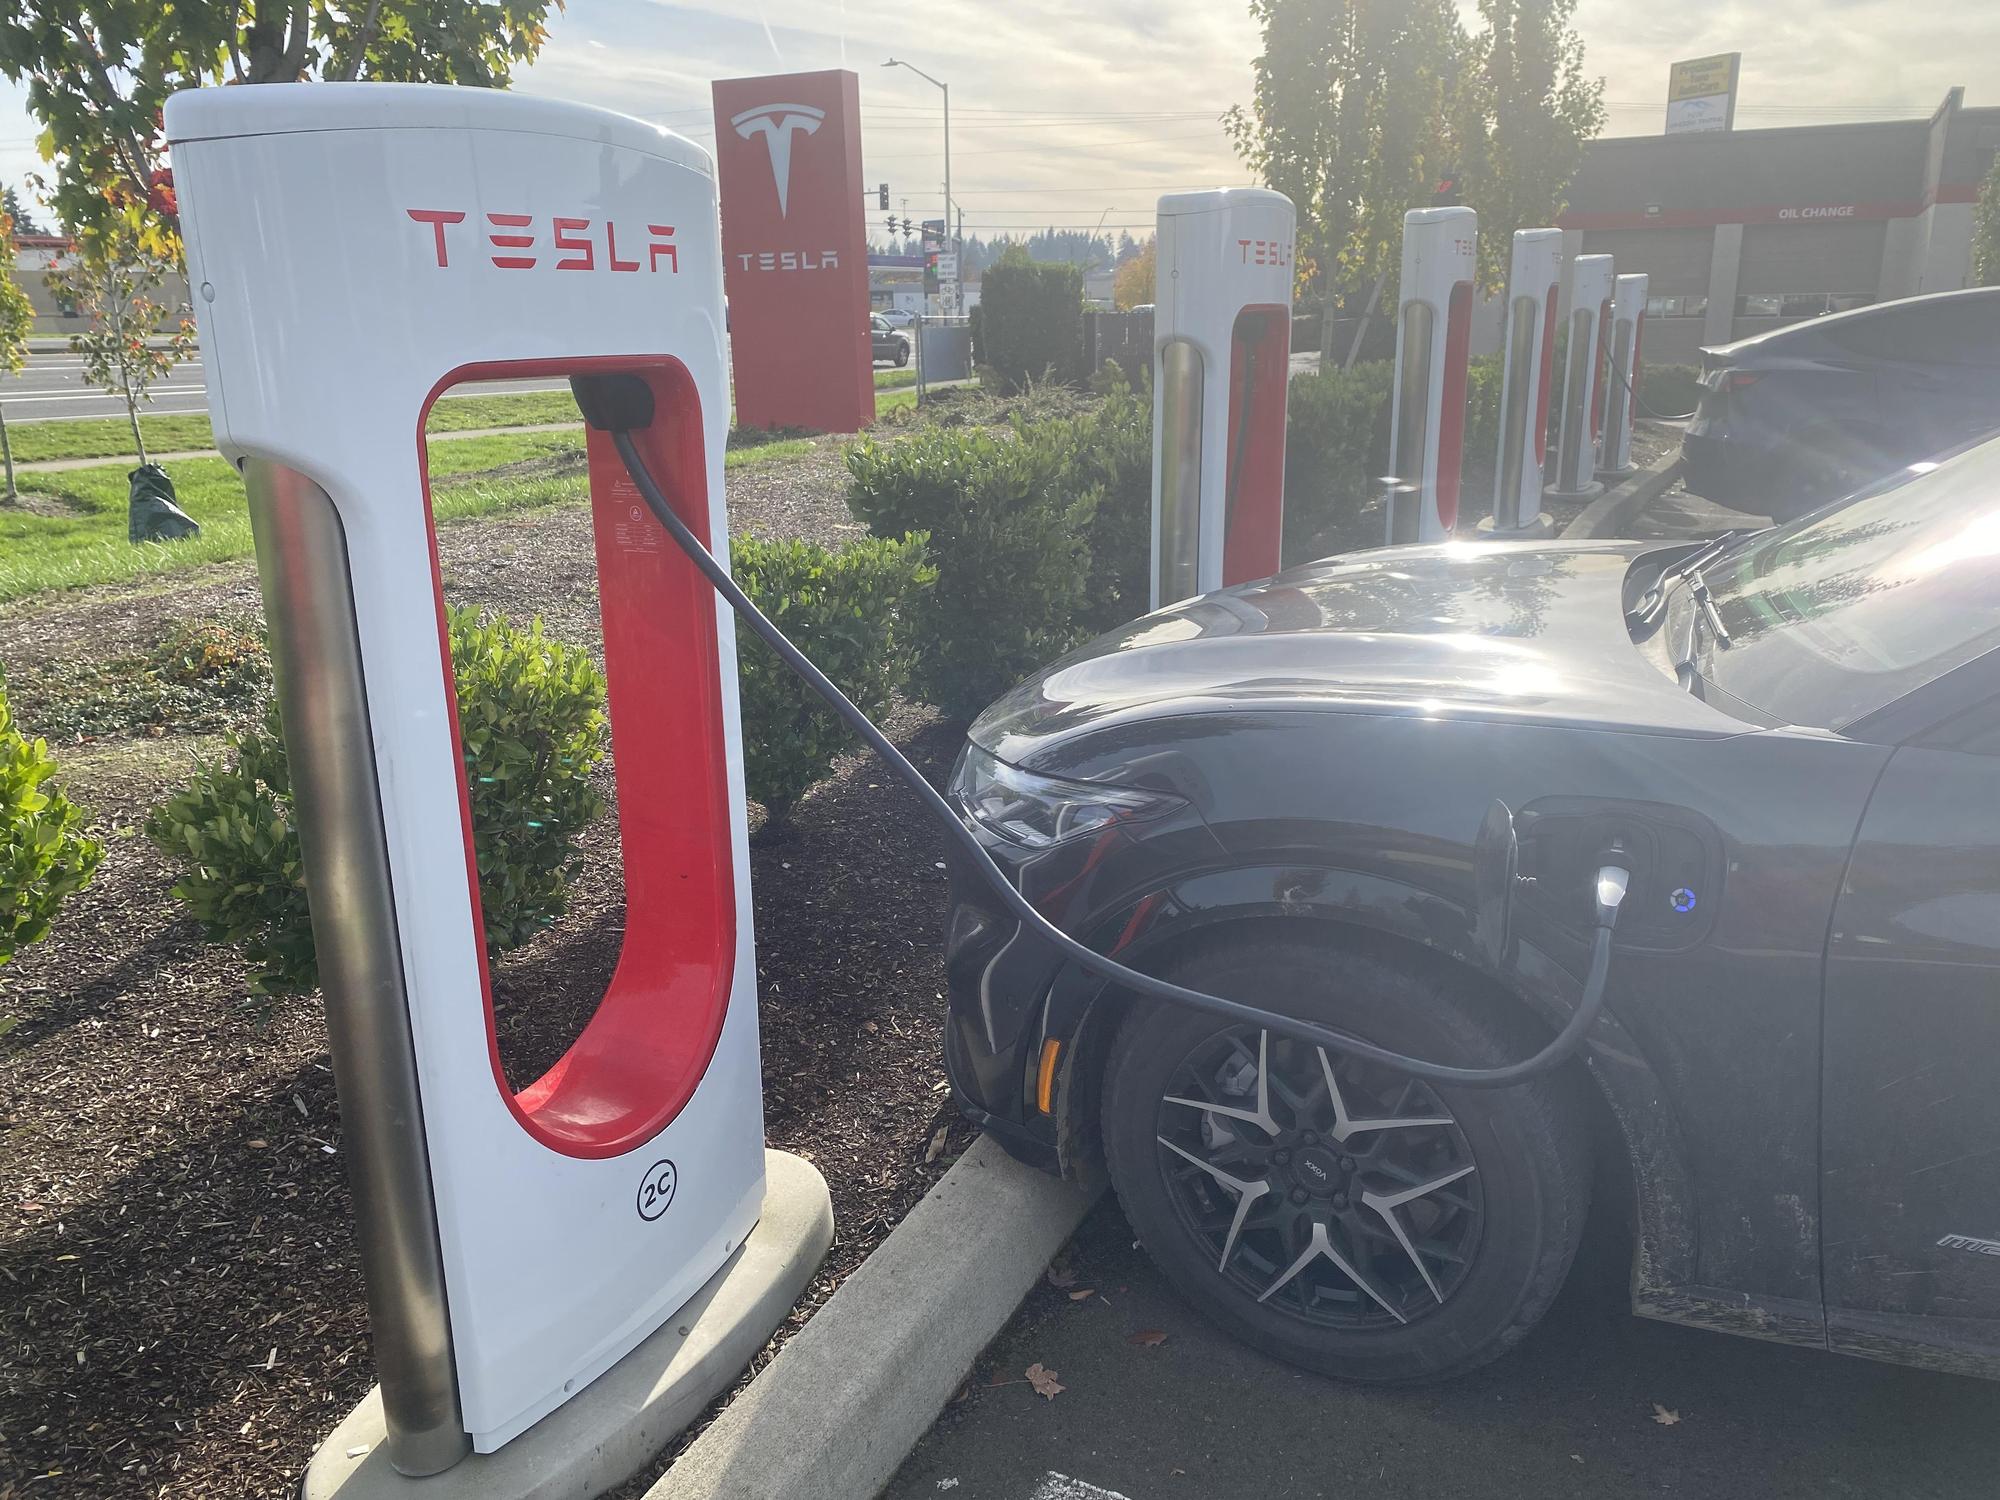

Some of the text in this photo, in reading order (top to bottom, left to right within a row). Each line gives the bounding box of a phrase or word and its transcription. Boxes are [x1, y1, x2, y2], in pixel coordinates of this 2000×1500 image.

[1779, 206, 1856, 219] OIL CHANGE
[406, 208, 678, 274] TESLA
[737, 250, 839, 272] TESLA
[1304, 1160, 1327, 1180] VOXX
[644, 1171, 671, 1209] 2C
